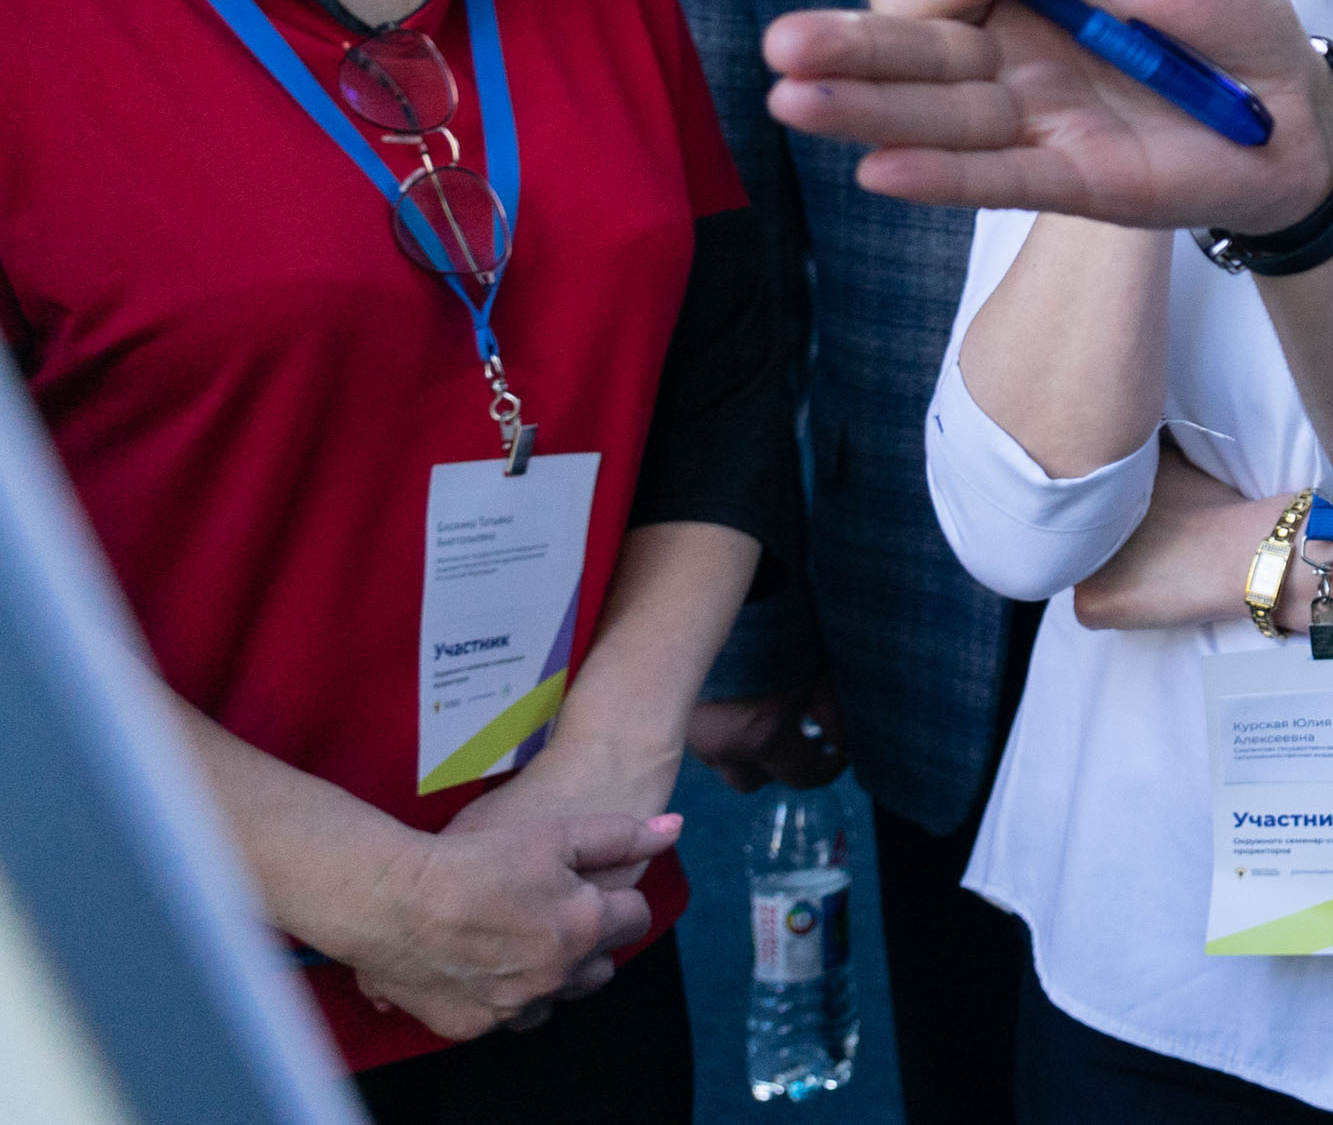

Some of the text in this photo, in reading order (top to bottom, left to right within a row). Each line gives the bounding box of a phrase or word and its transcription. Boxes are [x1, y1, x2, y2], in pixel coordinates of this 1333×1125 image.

[434, 634, 510, 660] Участник
[1233, 718, 1332, 732] Курская Юлия
[1233, 733, 1315, 745] Алексеевна
